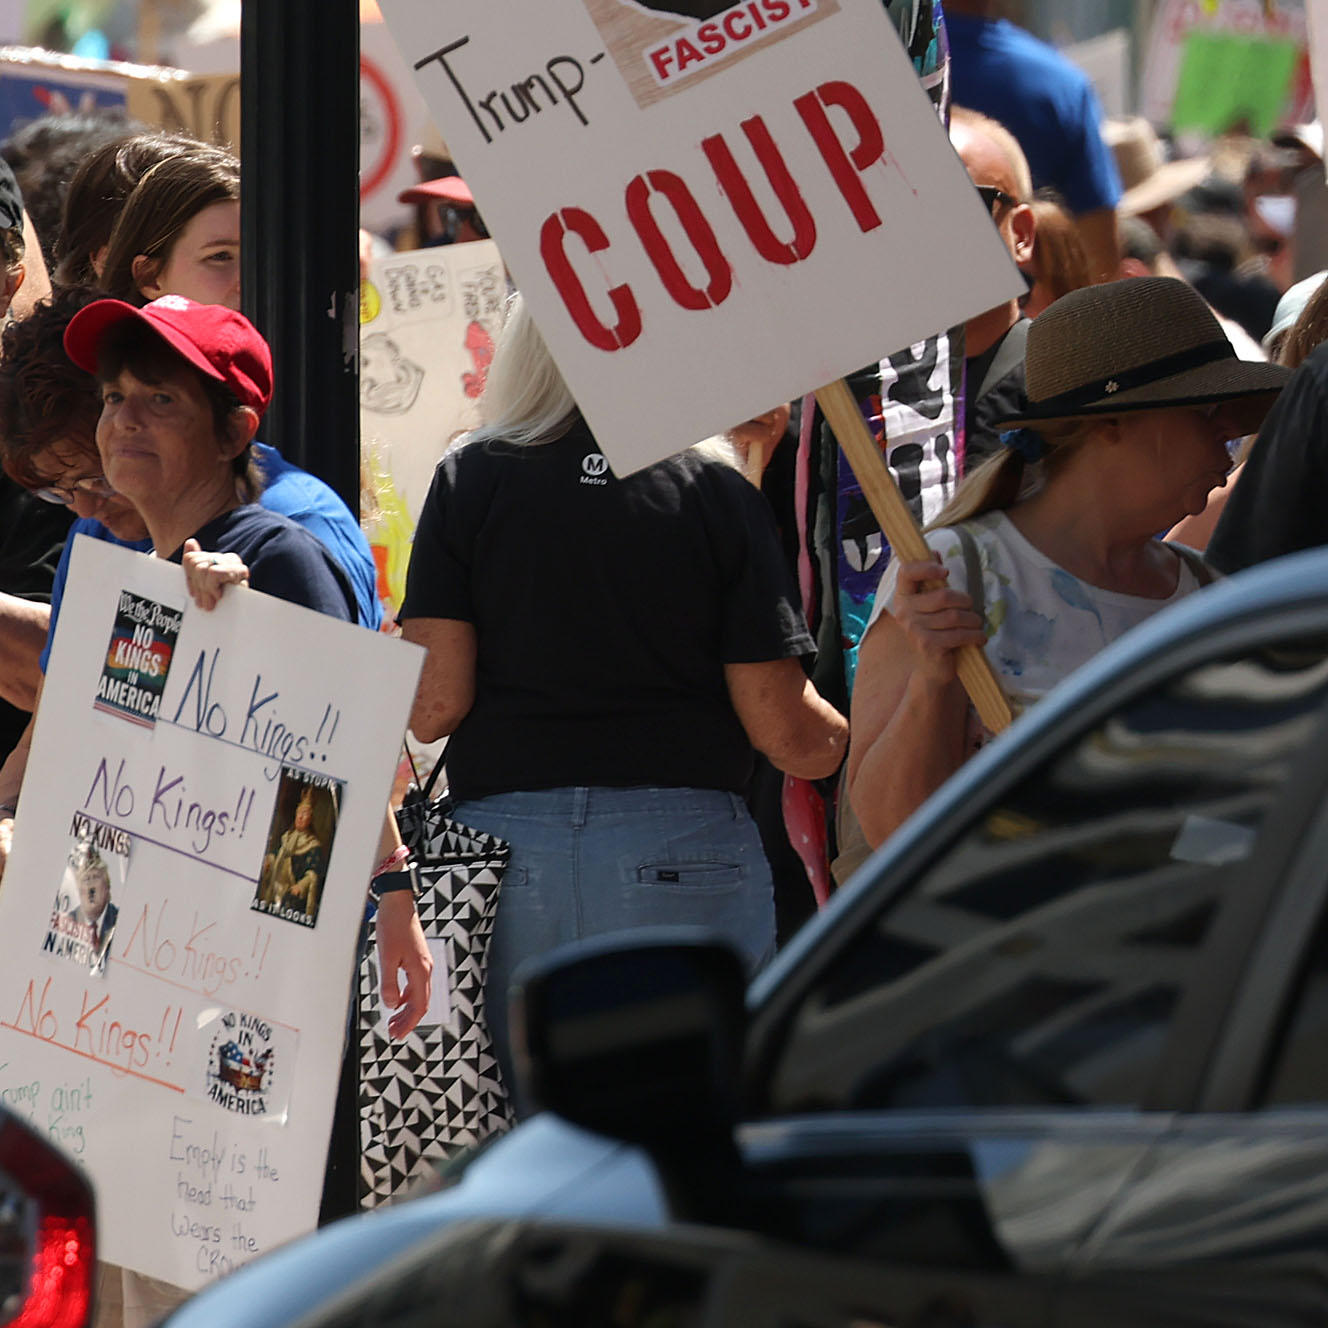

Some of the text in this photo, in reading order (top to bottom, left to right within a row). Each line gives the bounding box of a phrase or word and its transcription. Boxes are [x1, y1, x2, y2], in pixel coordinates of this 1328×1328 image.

[540, 79, 885, 353] COUP
[579, 475, 607, 485] Metro
[132, 624, 154, 648] NO
[115, 641, 162, 677] KINGS
[128, 672, 138, 684] IN
[173, 648, 227, 738] No
[97, 676, 161, 718] AMERICA
[84, 757, 134, 817] No
[94, 823, 131, 858] KINGS
[123, 898, 176, 971] No
[13, 976, 58, 1041] No
[222, 1012, 273, 1042] NO KINGS
[239, 1031, 253, 1047] IN
[208, 1085, 268, 1116] AMERICA
